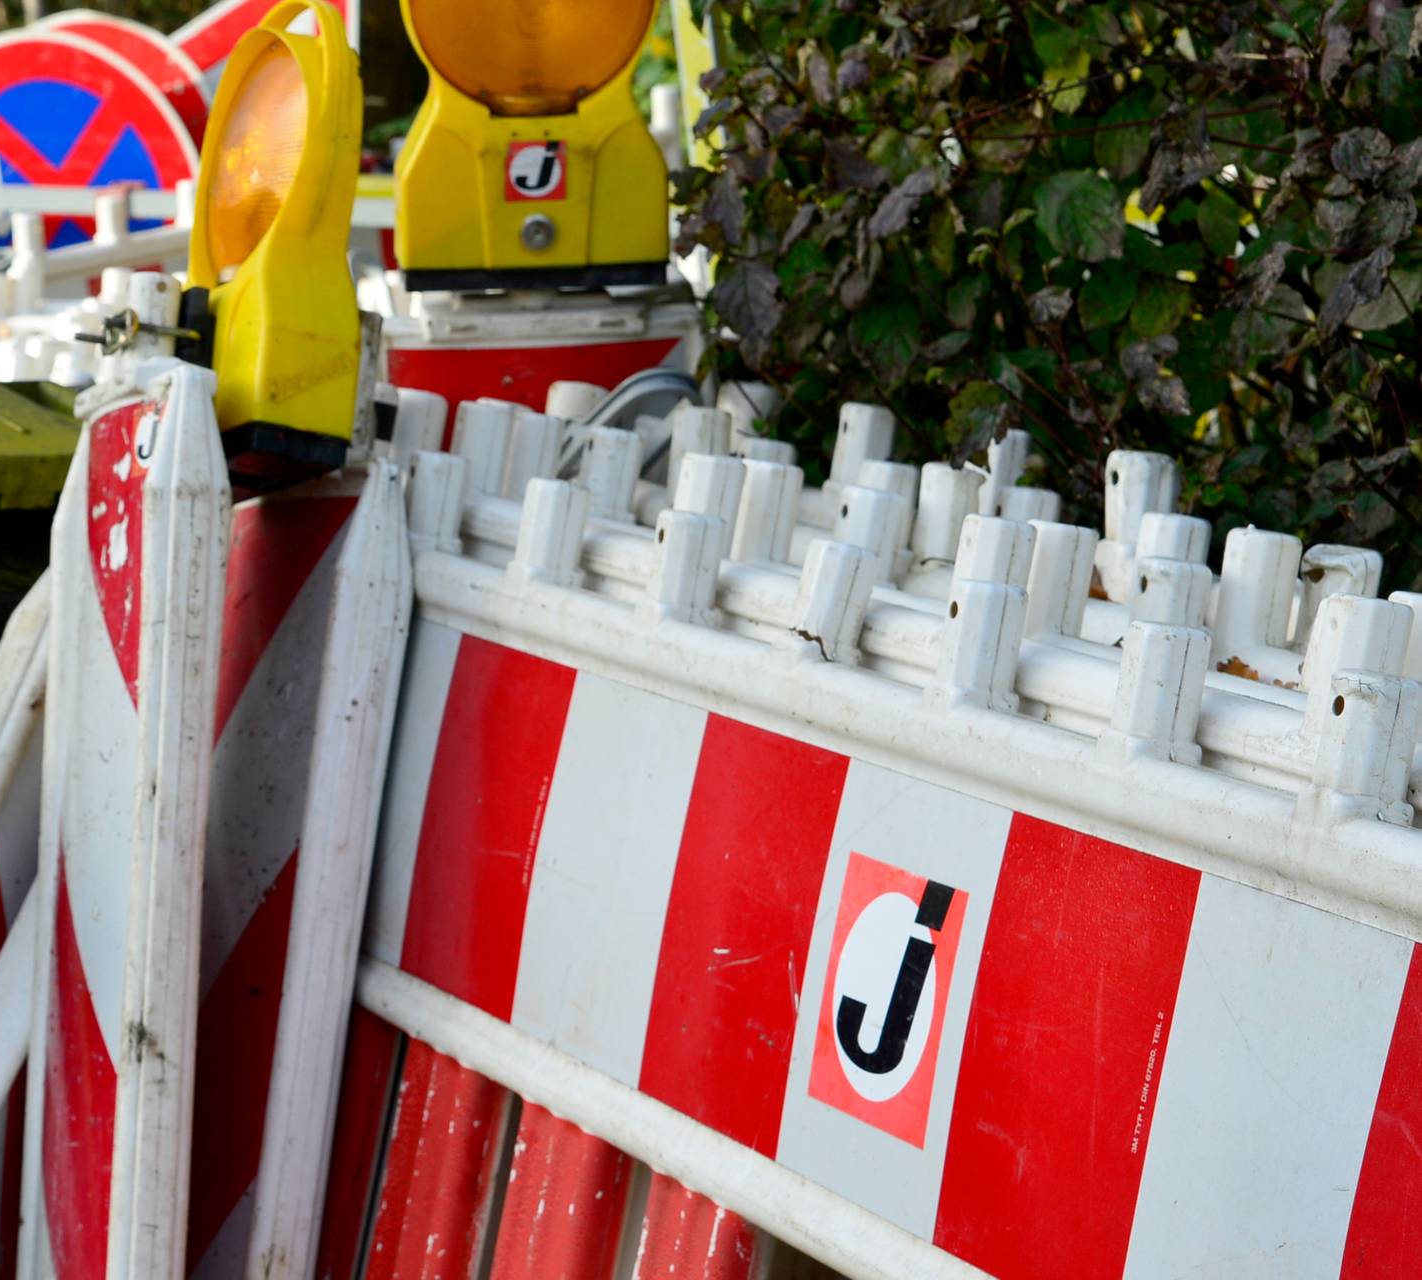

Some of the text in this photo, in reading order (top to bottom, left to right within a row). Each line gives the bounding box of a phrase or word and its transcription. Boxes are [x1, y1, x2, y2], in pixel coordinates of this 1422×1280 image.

[1134, 1113, 1143, 1136] TYP
[1141, 1082, 1150, 1103] DIN
[1152, 1021, 1163, 1045] TEIL
